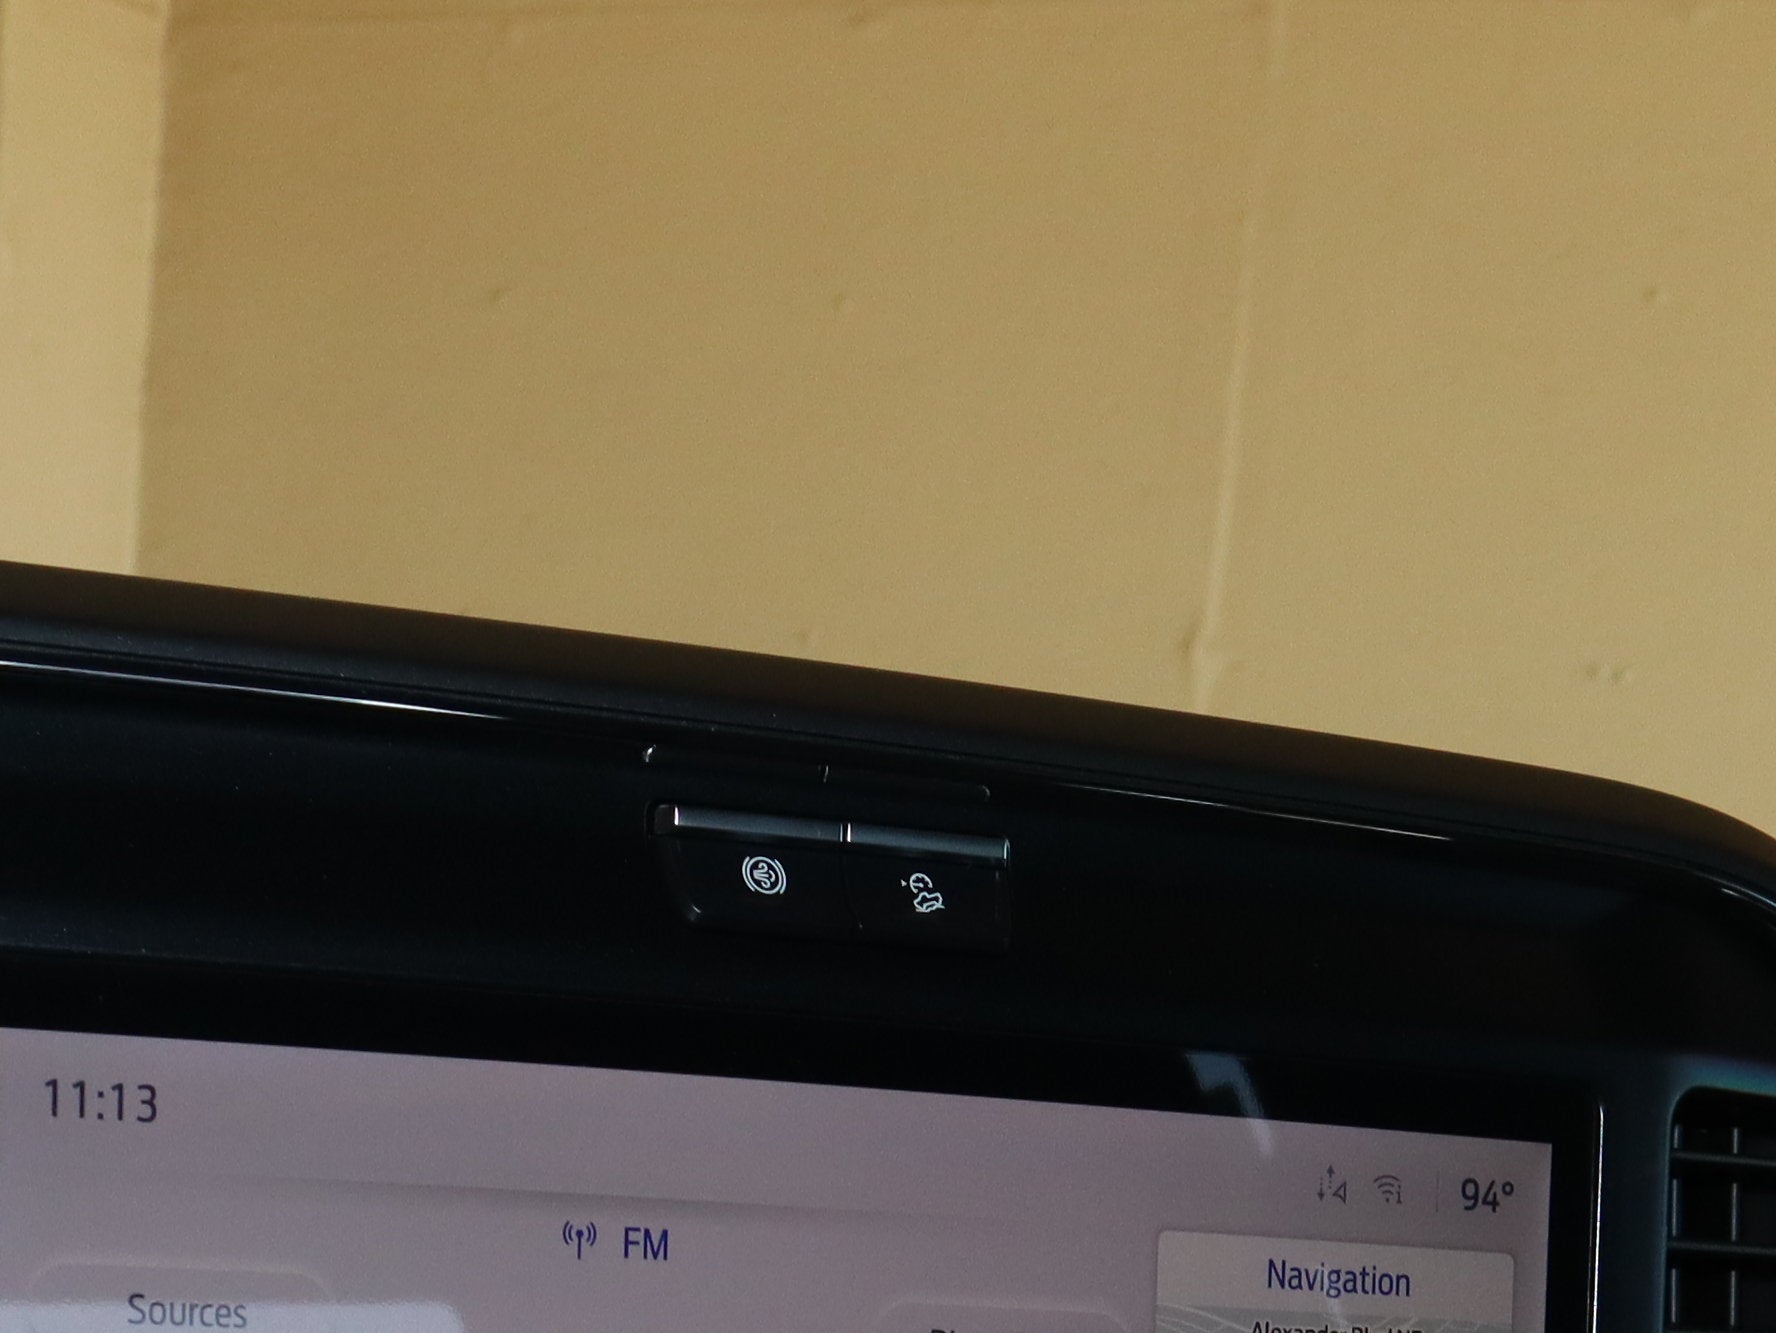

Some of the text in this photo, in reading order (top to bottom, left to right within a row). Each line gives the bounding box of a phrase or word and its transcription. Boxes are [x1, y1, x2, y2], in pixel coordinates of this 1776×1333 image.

[43, 1078, 158, 1123] 11:13
[623, 1228, 670, 1260] FM
[1266, 1259, 1411, 1298] Navigation
[127, 1293, 248, 1330] Sources
